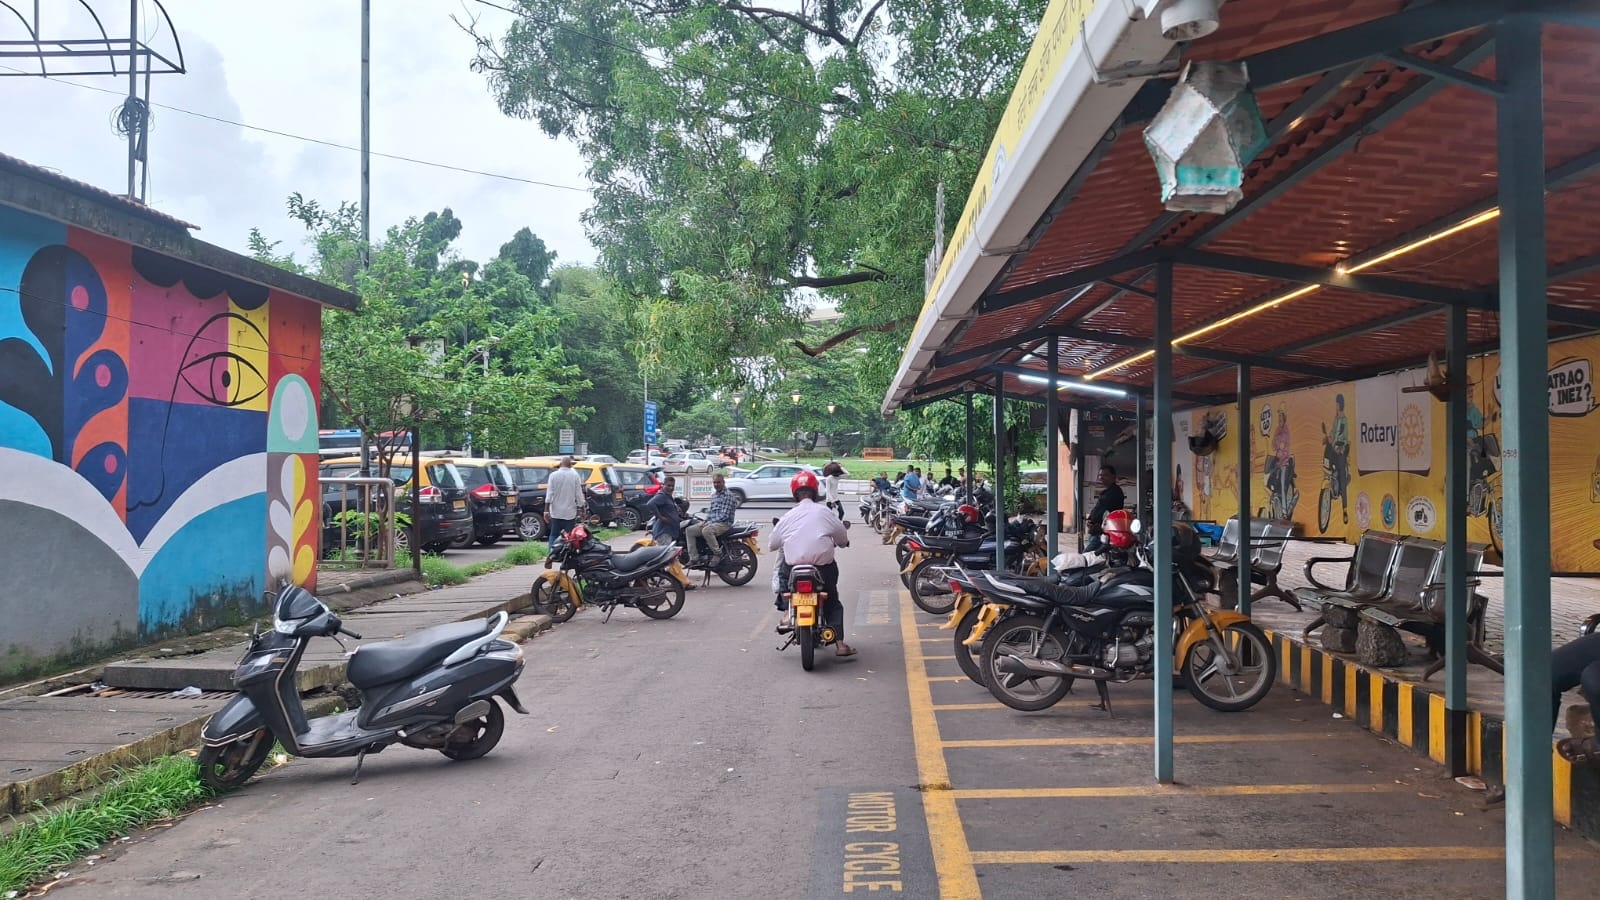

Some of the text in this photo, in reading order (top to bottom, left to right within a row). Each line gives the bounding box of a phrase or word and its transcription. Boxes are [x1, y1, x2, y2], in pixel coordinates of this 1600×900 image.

[1547, 368, 1584, 389] ATRAO
[1360, 422, 1397, 447] Rotary
[843, 792, 903, 893] MOTOR CYCLE
